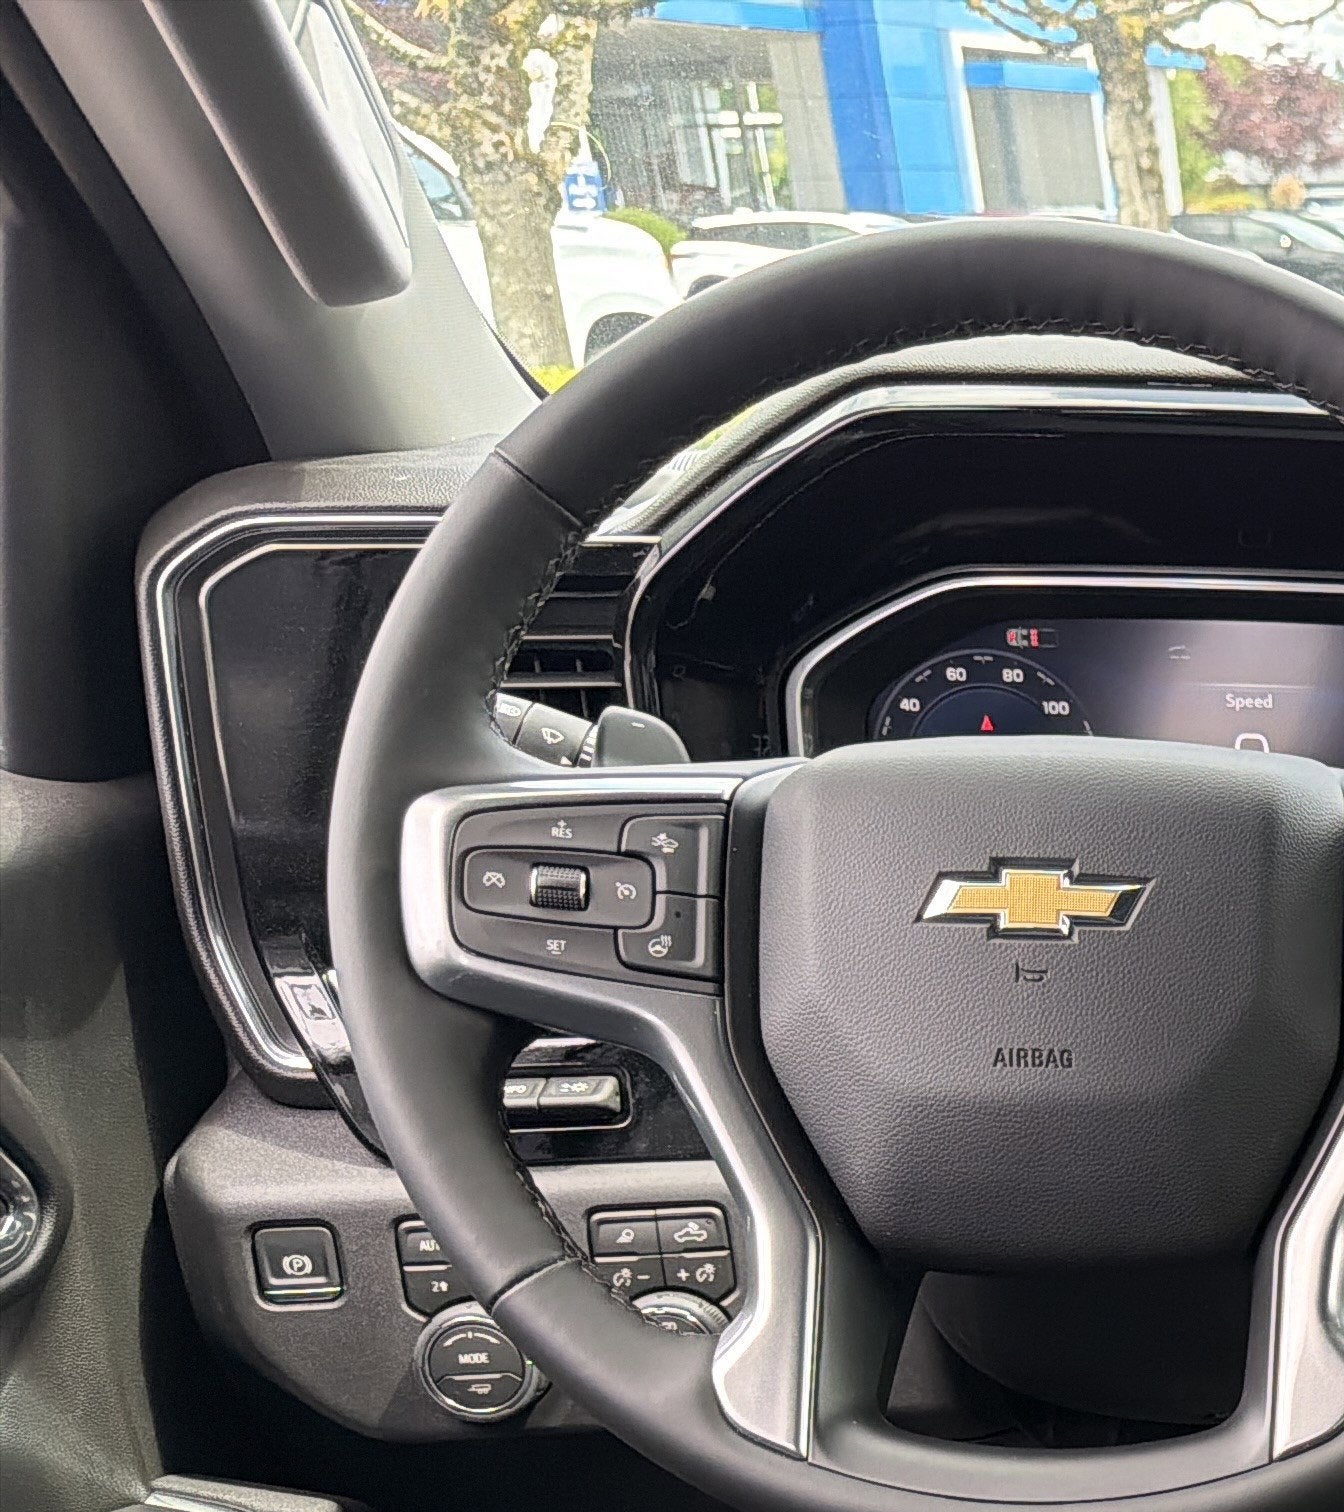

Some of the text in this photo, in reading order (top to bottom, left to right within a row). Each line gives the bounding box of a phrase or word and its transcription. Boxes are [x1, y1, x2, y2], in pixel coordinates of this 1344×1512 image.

[946, 667, 967, 682] 60
[1002, 668, 1024, 683] 80
[900, 698, 920, 712] 40
[1041, 701, 1070, 715] 100
[1225, 693, 1273, 712] Speed
[551, 826, 573, 839] RES
[546, 939, 567, 952] SET
[992, 1047, 1073, 1069] AIRBAG
[458, 1352, 490, 1365] MODE
